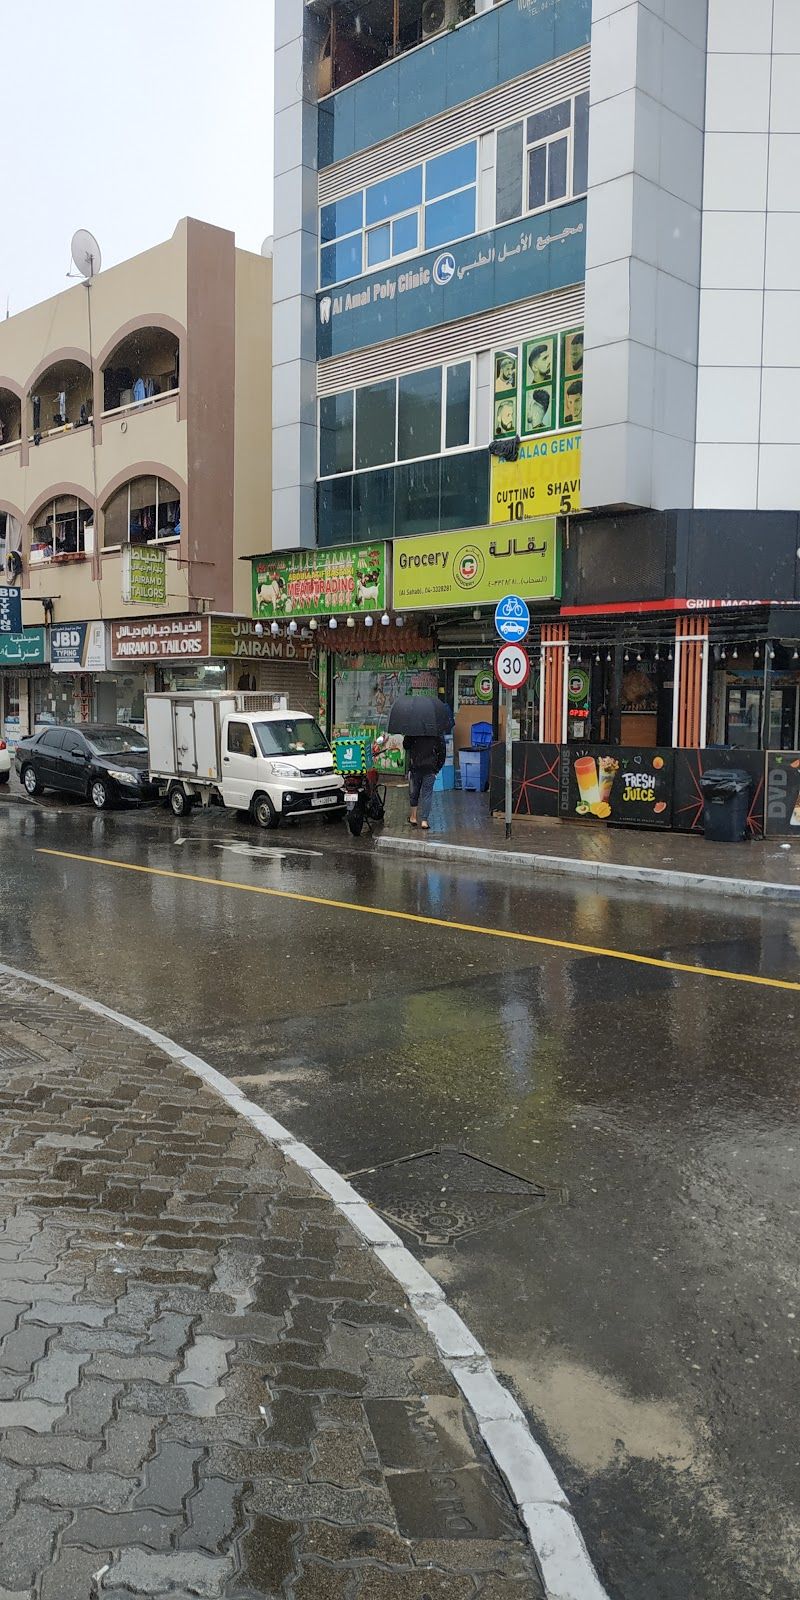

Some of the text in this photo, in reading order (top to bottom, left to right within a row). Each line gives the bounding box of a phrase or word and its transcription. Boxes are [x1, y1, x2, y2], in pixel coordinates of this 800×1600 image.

[457, 222, 584, 280] مجمع الأمل الطبي
[332, 266, 431, 315] Al Amal Poly Clinic
[518, 442, 548, 460] ALAQ
[496, 486, 535, 503] CUTTING
[508, 501, 525, 520] 10
[489, 537, 547, 558] بقالة
[399, 551, 449, 569] Grocery
[131, 586, 164, 599] TAILORS
[287, 577, 355, 596] MEAT TRADING
[0, 597, 11, 631] TYPING
[171, 620, 201, 636] الخياط
[52, 631, 80, 647] JBD
[116, 638, 202, 656] JAIRAM D. TAILORS
[56, 649, 77, 657] TYPING
[231, 640, 282, 658] JAIRAM
[503, 658, 521, 674] 30
[561, 749, 571, 810] DELICIOUS
[621, 772, 656, 789] FRESH
[622, 786, 656, 802] JUICE
[768, 768, 788, 818] DVD
